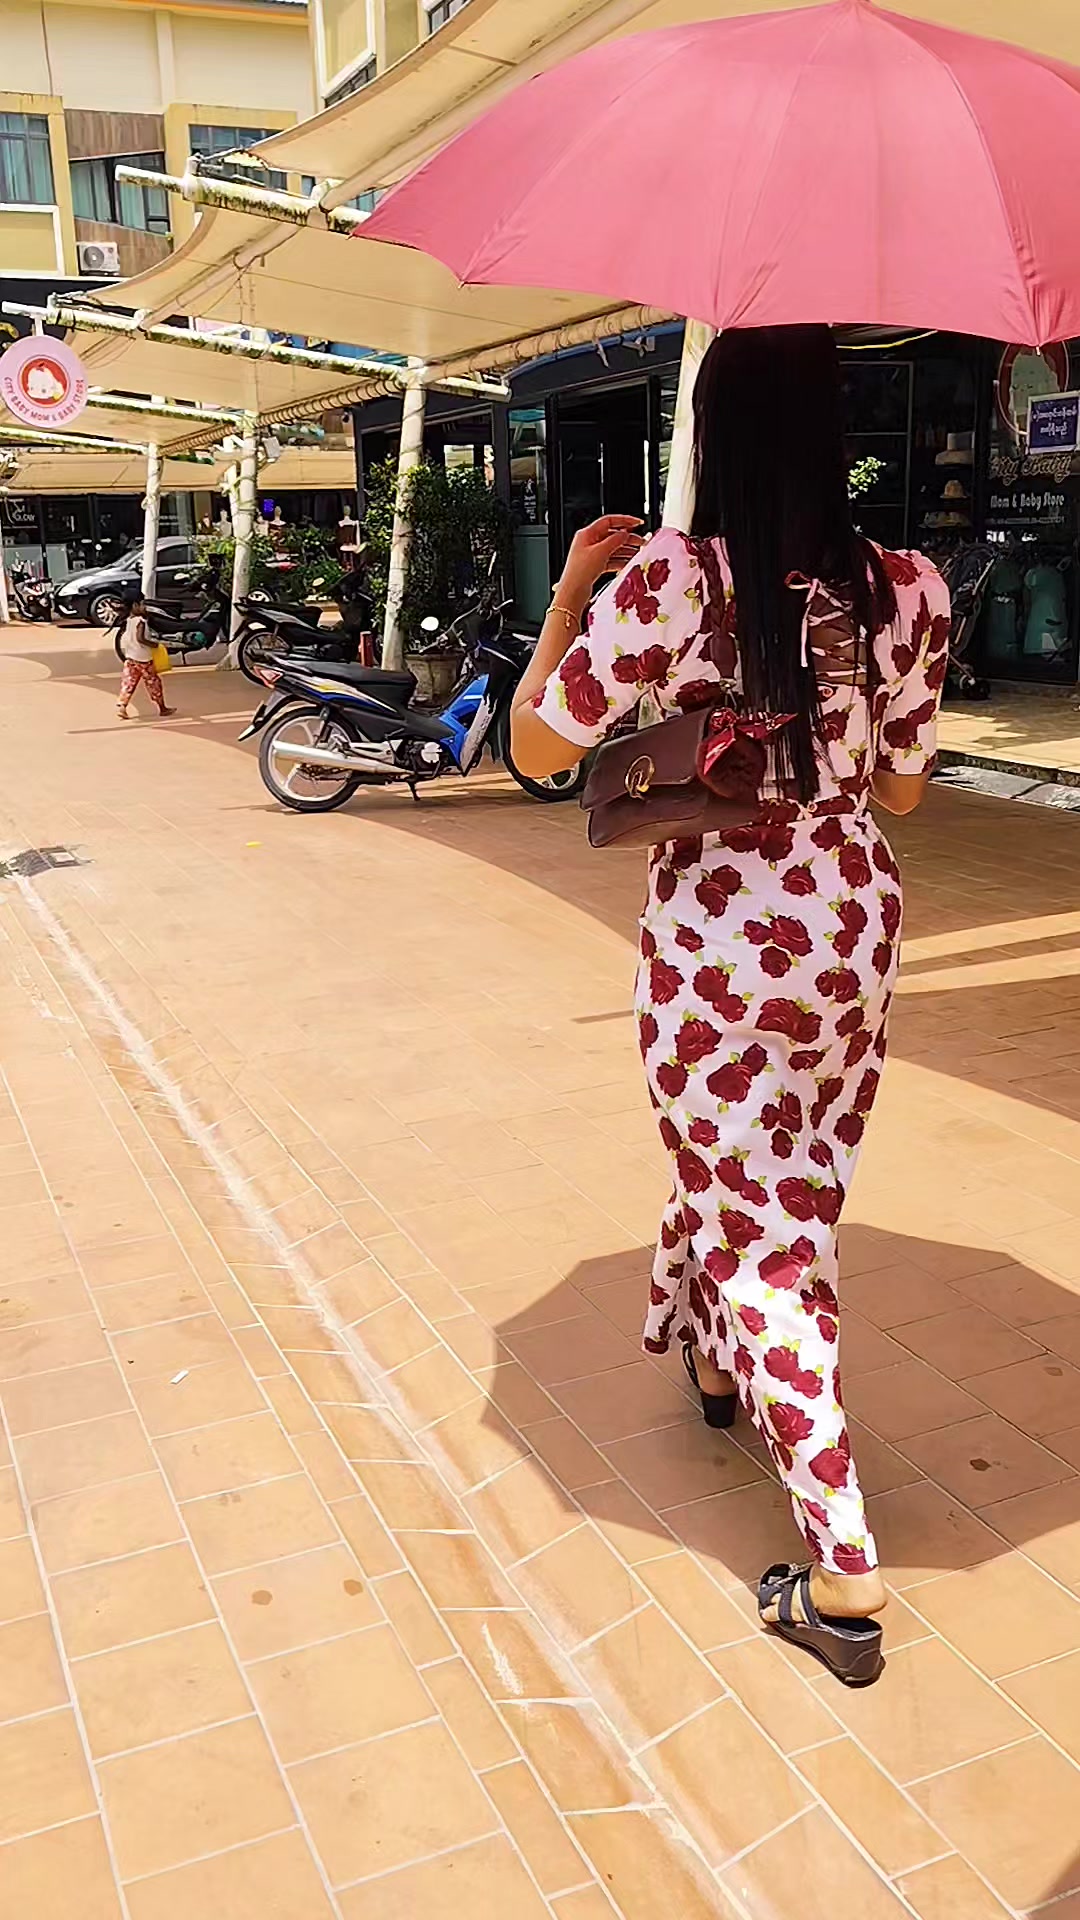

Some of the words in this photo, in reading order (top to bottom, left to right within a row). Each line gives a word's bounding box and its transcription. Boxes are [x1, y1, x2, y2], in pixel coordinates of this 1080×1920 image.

[11, 395, 30, 414] BABY
[31, 411, 50, 421] MOM
[58, 404, 77, 420] BABY
[72, 379, 84, 403] STORE
[990, 495, 1009, 508] Mom
[1020, 492, 1041, 510] Baby
[1043, 491, 1065, 507] Store
